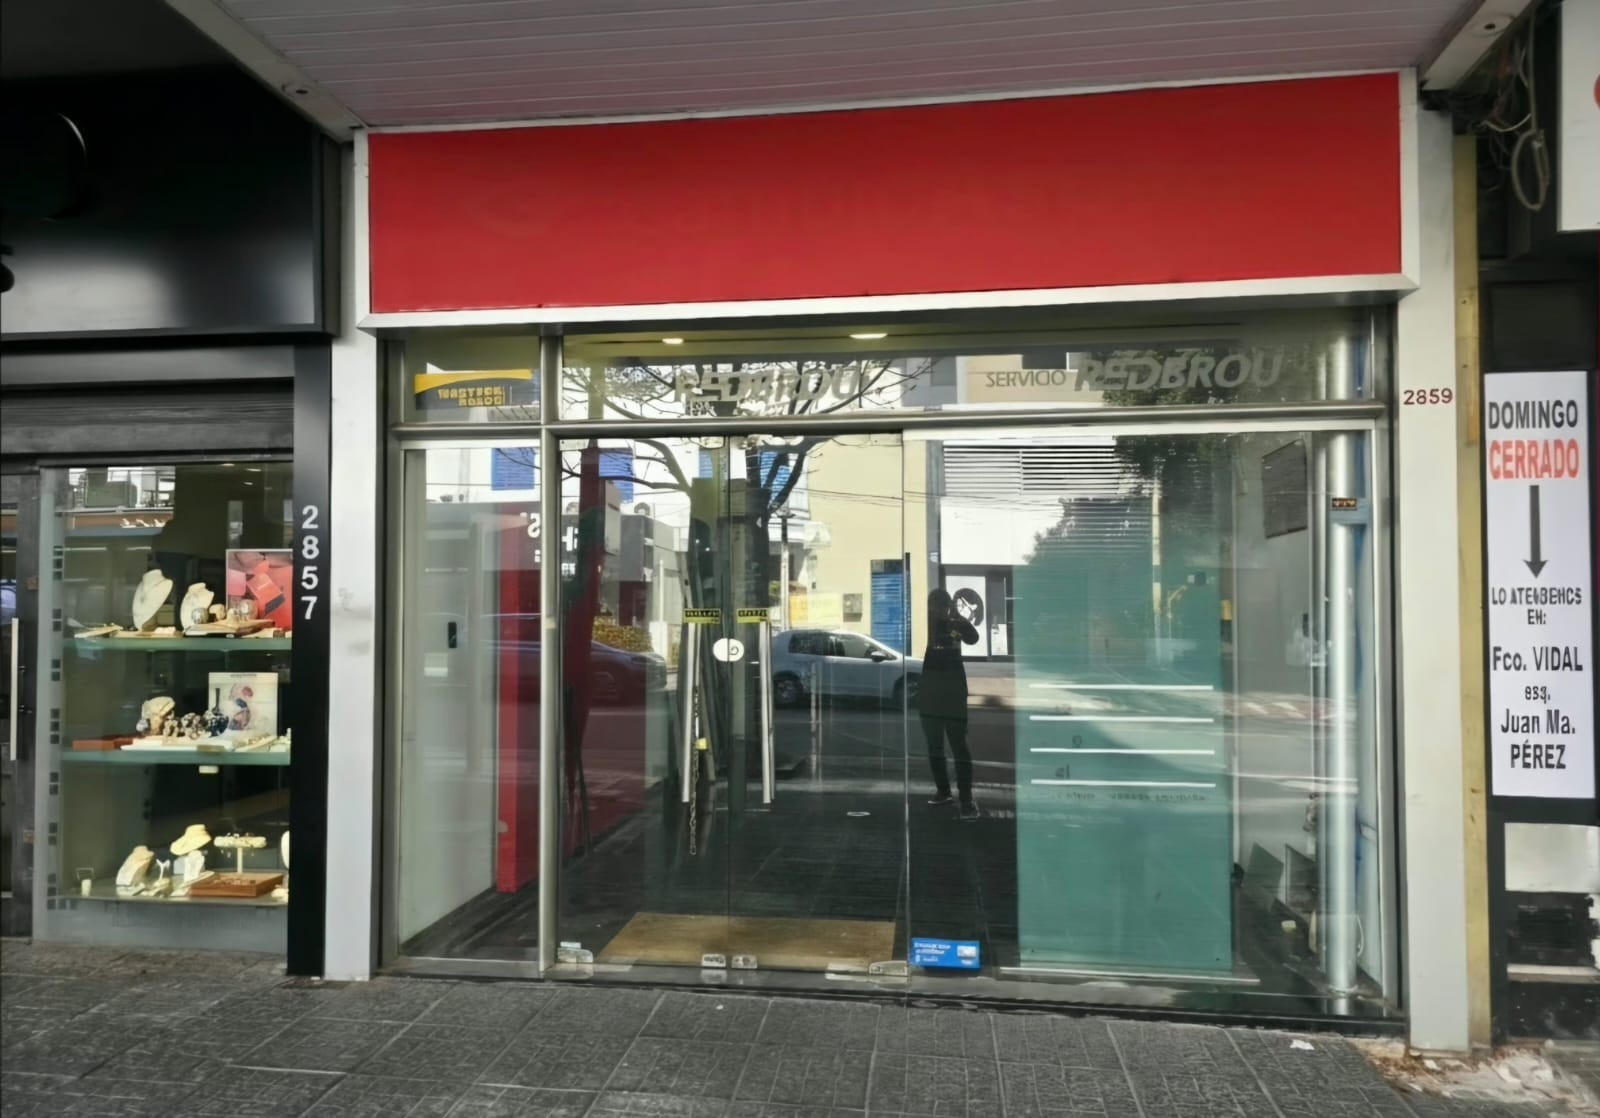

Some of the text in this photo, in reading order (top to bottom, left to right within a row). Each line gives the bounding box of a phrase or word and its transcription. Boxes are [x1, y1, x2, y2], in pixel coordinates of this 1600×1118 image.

[985, 353, 1283, 392] SERVICIO REDBROU
[1403, 387, 1454, 406] 2859
[1488, 399, 1578, 430] DOMINGO
[1489, 438, 1580, 480] CERRADO
[301, 505, 320, 620] 2857
[1492, 586, 1507, 606] LO
[1493, 645, 1584, 672] Fco. VIDAL
[1500, 707, 1576, 735] Juan Ma.
[1510, 738, 1566, 770] PÉREZ
